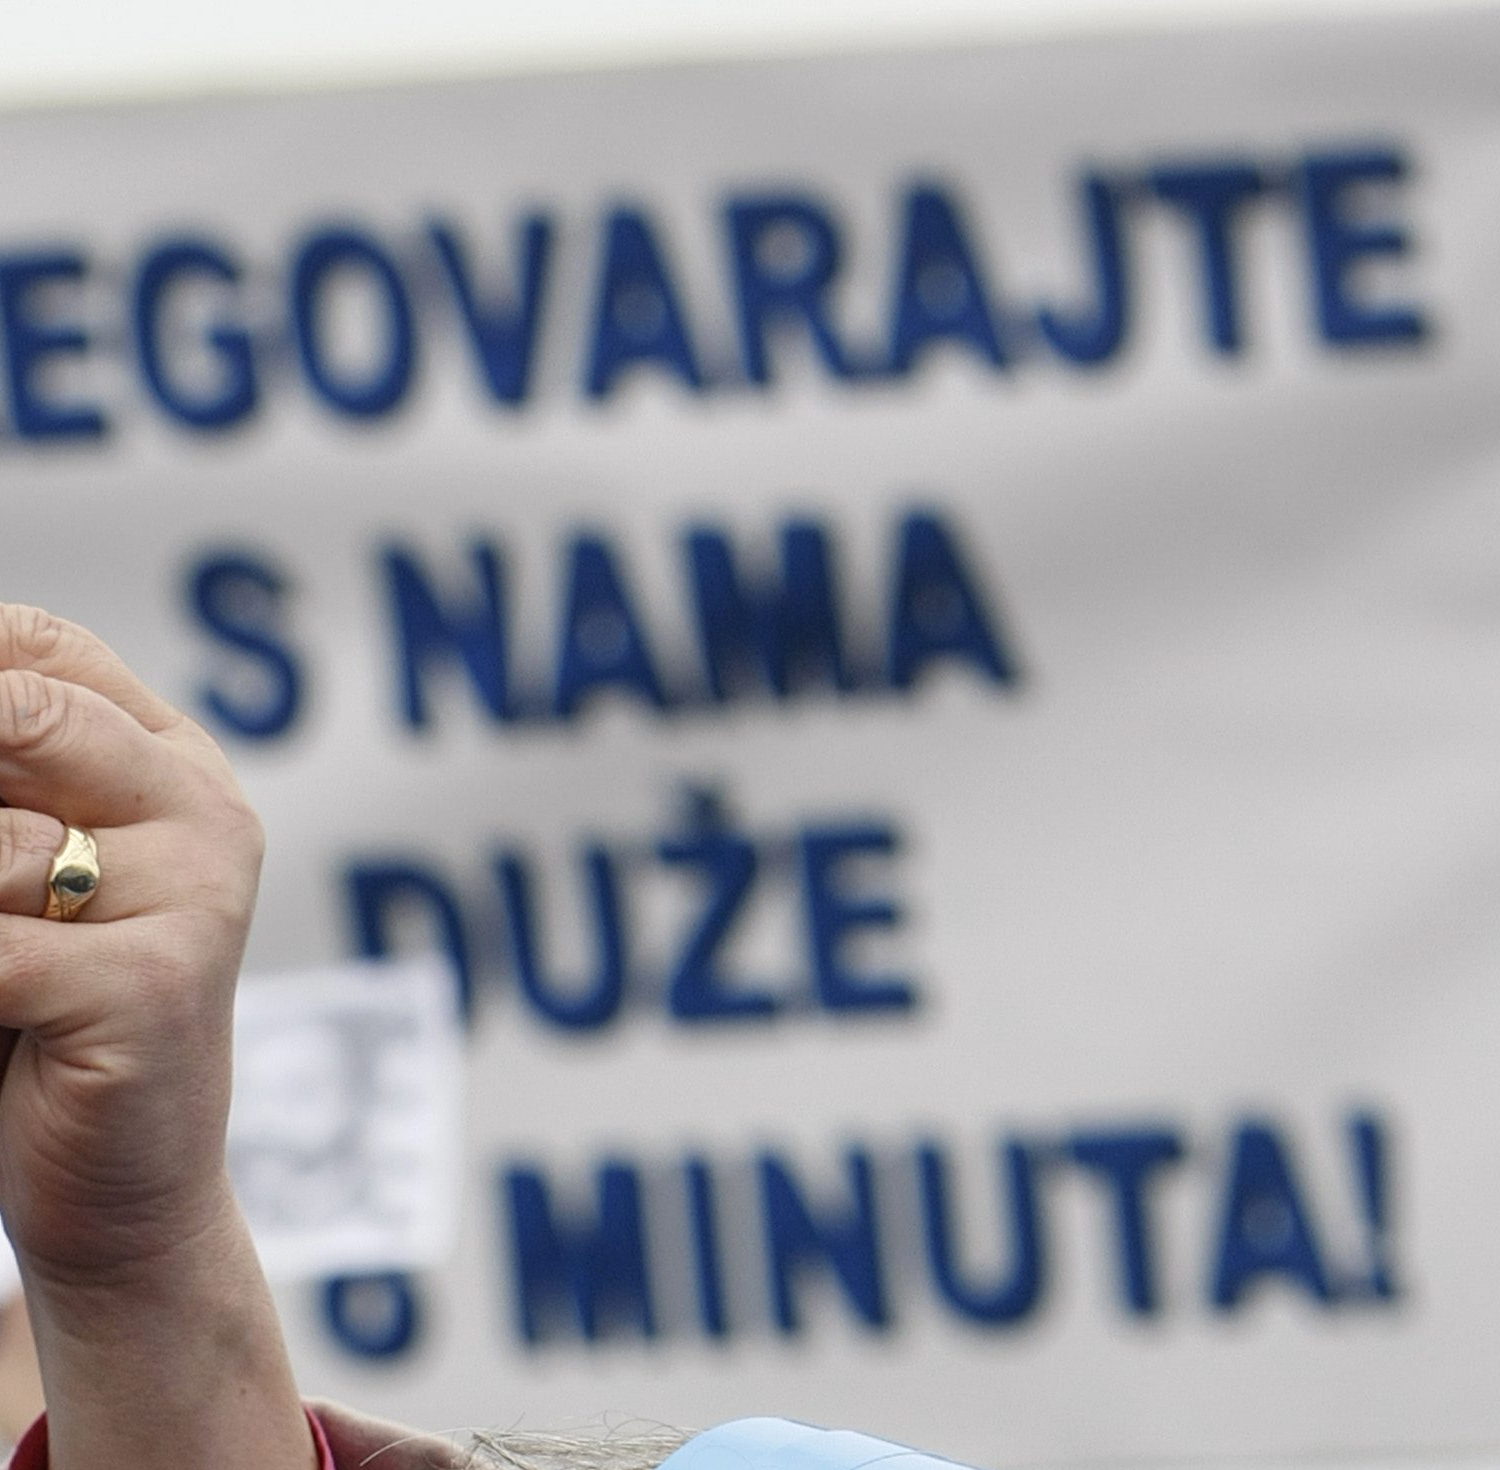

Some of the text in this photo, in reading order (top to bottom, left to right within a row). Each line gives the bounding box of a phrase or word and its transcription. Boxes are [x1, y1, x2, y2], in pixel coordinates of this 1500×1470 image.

[186, 506, 1016, 742] S NAMA
[342, 780, 918, 1034] DUŽE
[496, 1110, 1398, 1346] MINUTA!
